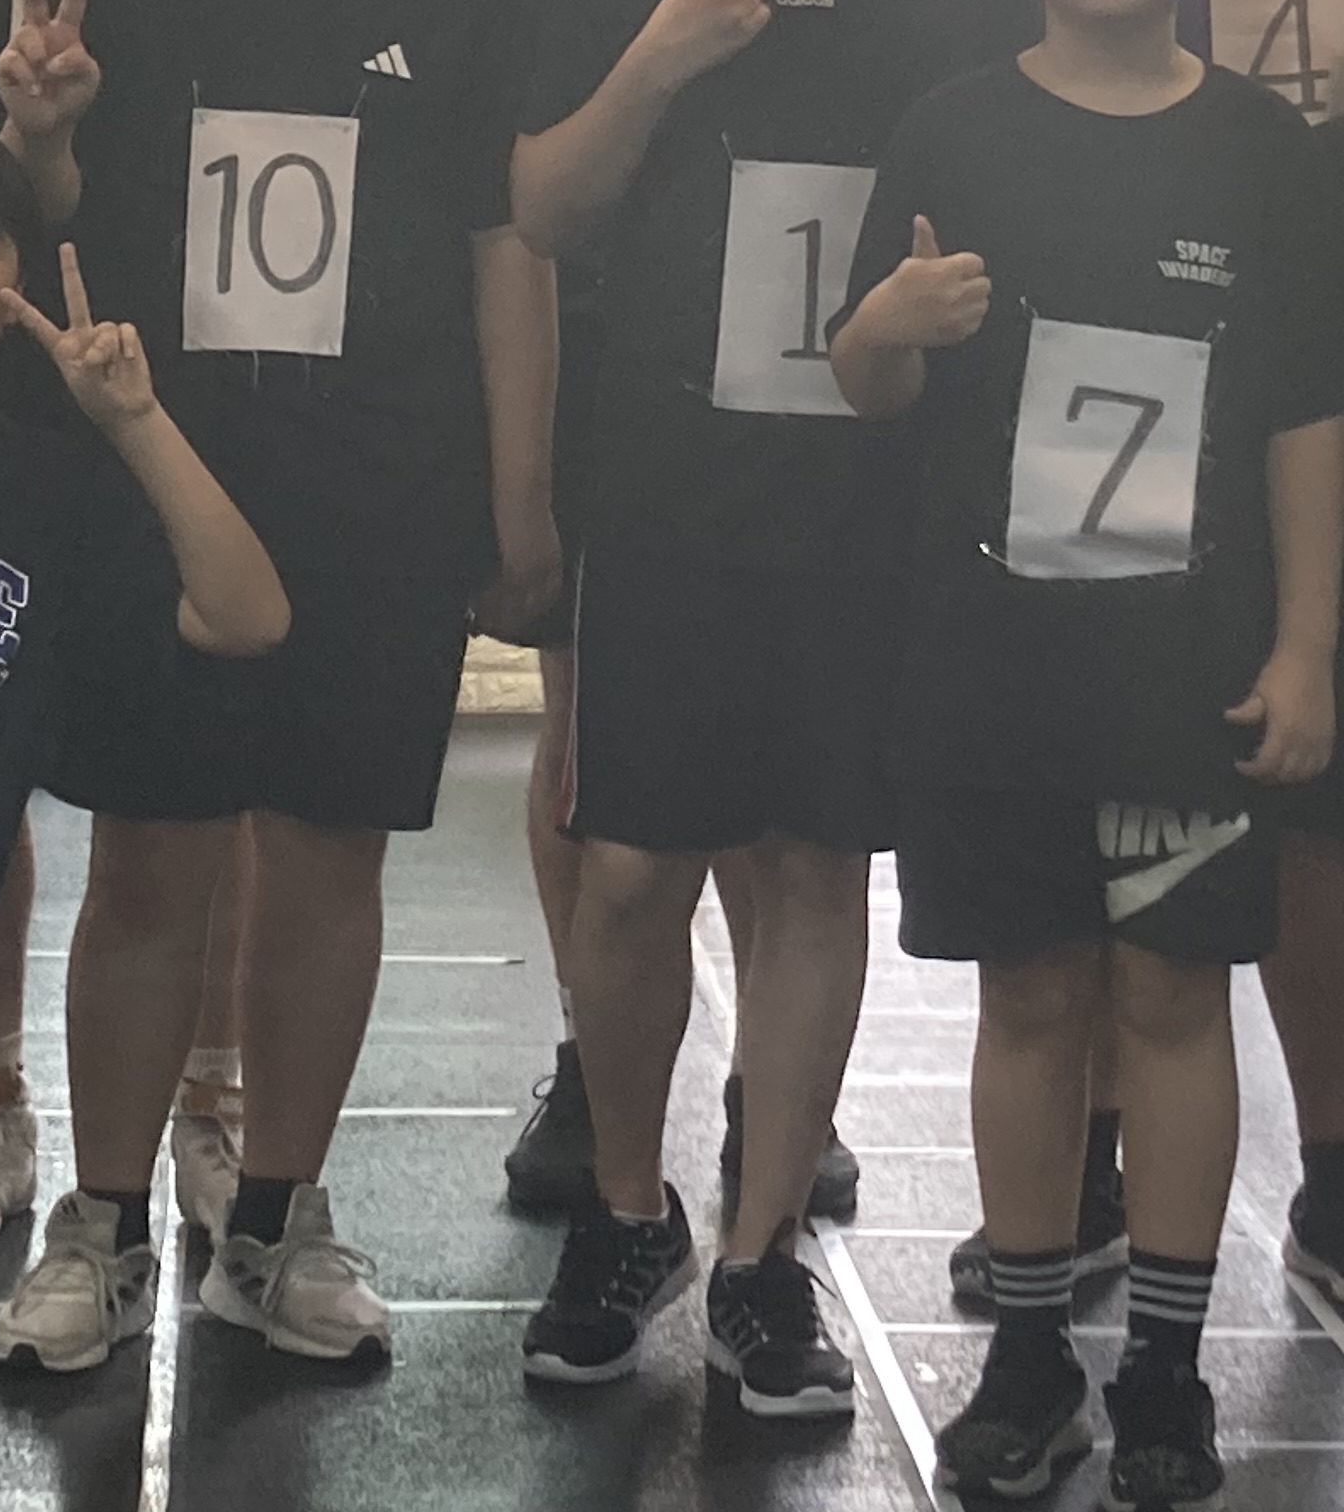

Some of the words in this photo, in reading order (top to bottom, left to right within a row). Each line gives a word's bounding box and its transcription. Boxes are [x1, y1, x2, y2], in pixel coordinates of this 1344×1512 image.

[203, 152, 337, 294] 10
[781, 218, 831, 362] 1
[1175, 239, 1232, 268] SPACE
[1065, 385, 1163, 535] 7
